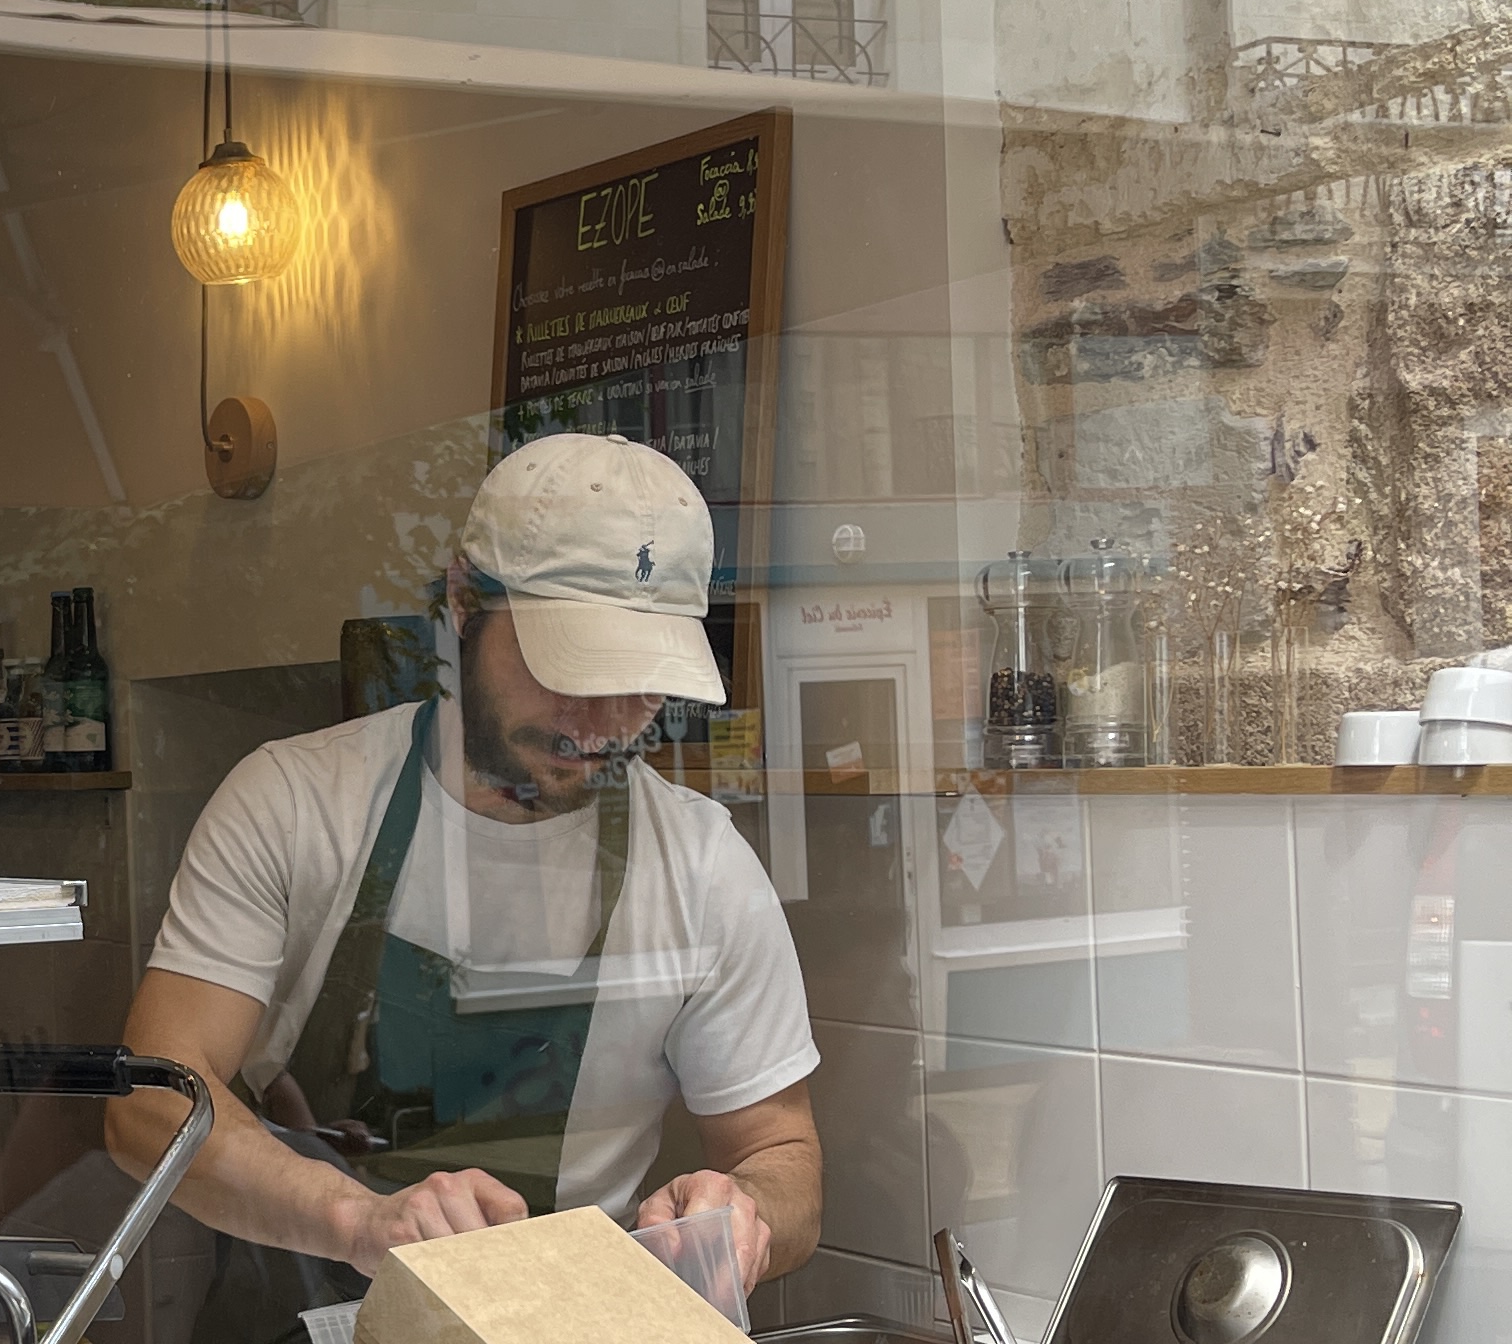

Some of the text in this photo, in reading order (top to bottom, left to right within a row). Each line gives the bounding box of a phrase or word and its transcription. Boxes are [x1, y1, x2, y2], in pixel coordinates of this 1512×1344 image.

[576, 171, 659, 251] EZOPE
[696, 196, 733, 226] Salade
[526, 314, 571, 344] RILLETTES
[574, 311, 587, 334] DE
[588, 301, 649, 331] MAQUEREAUX
[684, 360, 717, 388] salade
